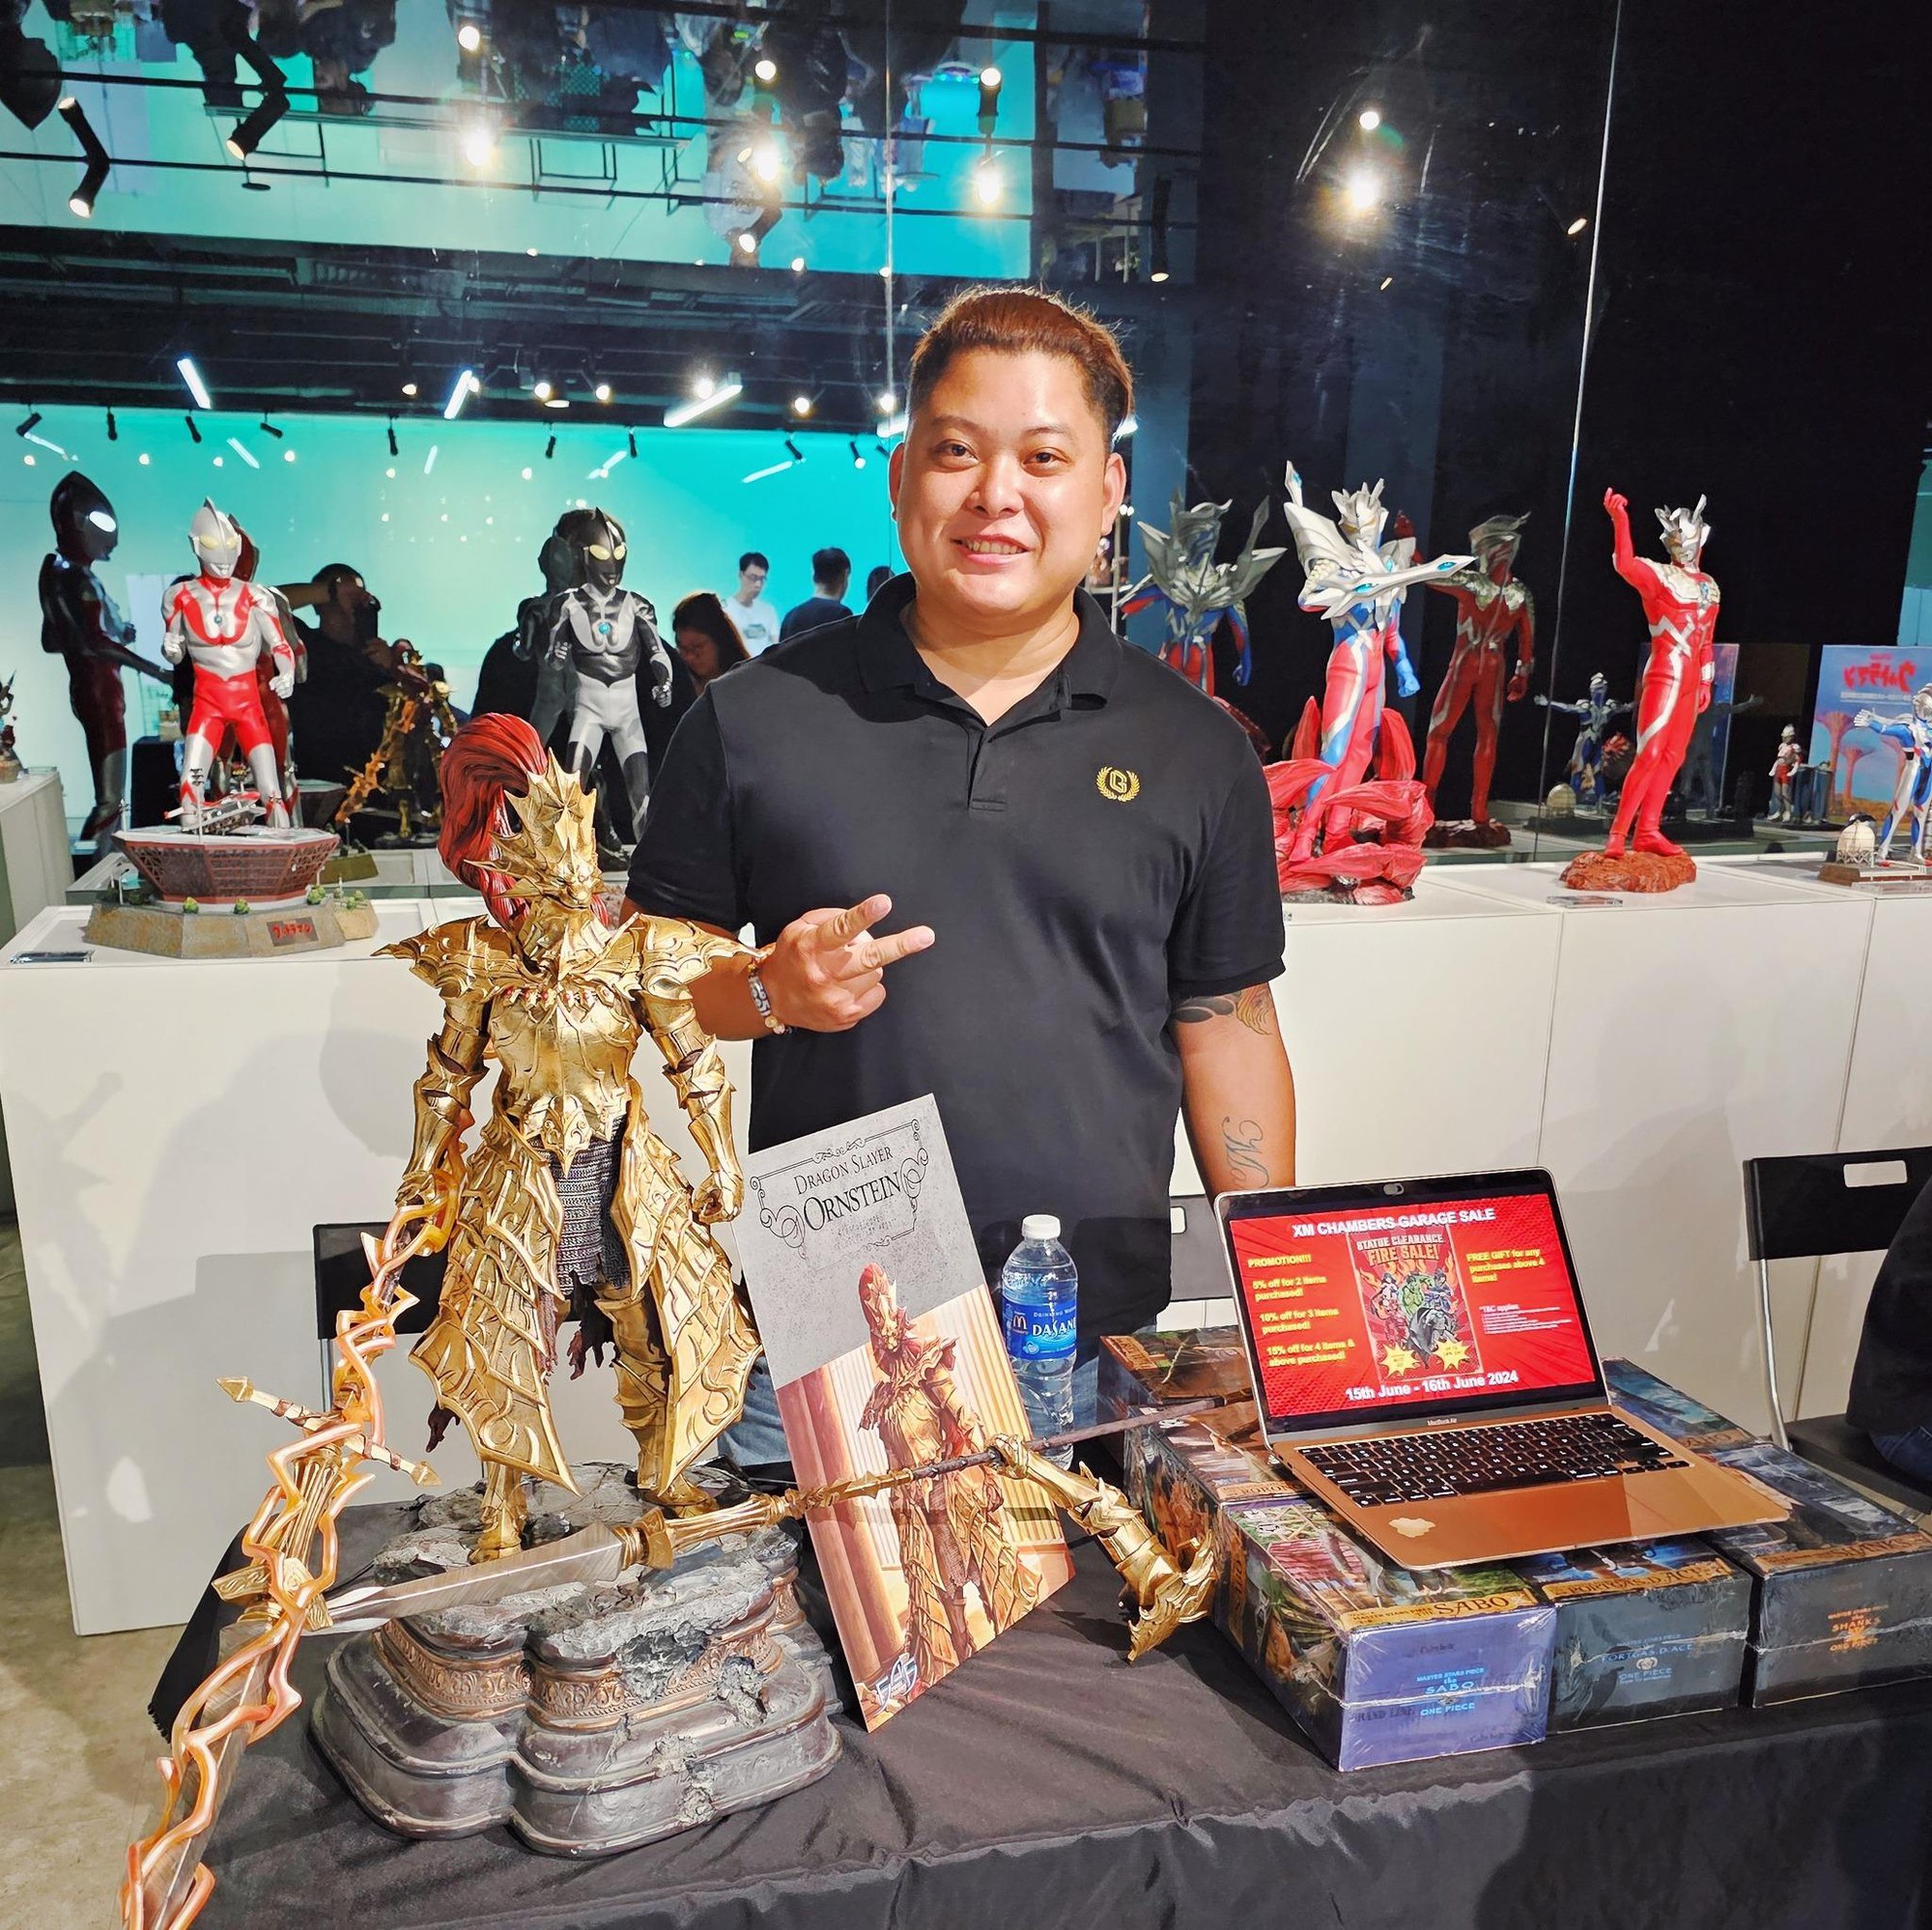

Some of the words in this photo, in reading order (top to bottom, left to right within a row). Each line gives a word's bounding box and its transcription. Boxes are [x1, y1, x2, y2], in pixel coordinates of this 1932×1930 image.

[804, 1172, 900, 1231] ORNSTEIN
[1292, 1224, 1314, 1237] XM
[1318, 1217, 1395, 1235] CHAMBERS
[1399, 1211, 1458, 1229] GARAGE
[1459, 1207, 1495, 1222] SALE
[1356, 1236, 1390, 1251] STATUE
[1391, 1234, 1443, 1246] CLEARANCE
[1367, 1246, 1399, 1266] FIRE
[1401, 1243, 1439, 1261] SALE!
[1466, 1252, 1491, 1262] FREE
[1492, 1250, 1511, 1260] GIFT
[1267, 1279, 1281, 1289] off
[1281, 1277, 1294, 1287] for
[1294, 1277, 1302, 1286] 2
[1260, 1313, 1279, 1322] 10%
[1280, 1311, 1293, 1321] off
[1293, 1310, 1306, 1320] for
[1307, 1309, 1314, 1318] 3
[1267, 1346, 1287, 1356] 15%
[1287, 1344, 1300, 1354] off
[1300, 1343, 1314, 1352] for
[1315, 1343, 1321, 1351] 4
[1345, 1385, 1376, 1401] 15th
[1378, 1383, 1411, 1398] June
[1422, 1378, 1451, 1393] 16th
[1453, 1376, 1486, 1389] June
[1488, 1370, 1519, 1385] 2024
[1434, 1597, 1509, 1615] SABO
[1426, 1681, 1474, 1694] SABO
[1445, 1702, 1475, 1713] PIECE
